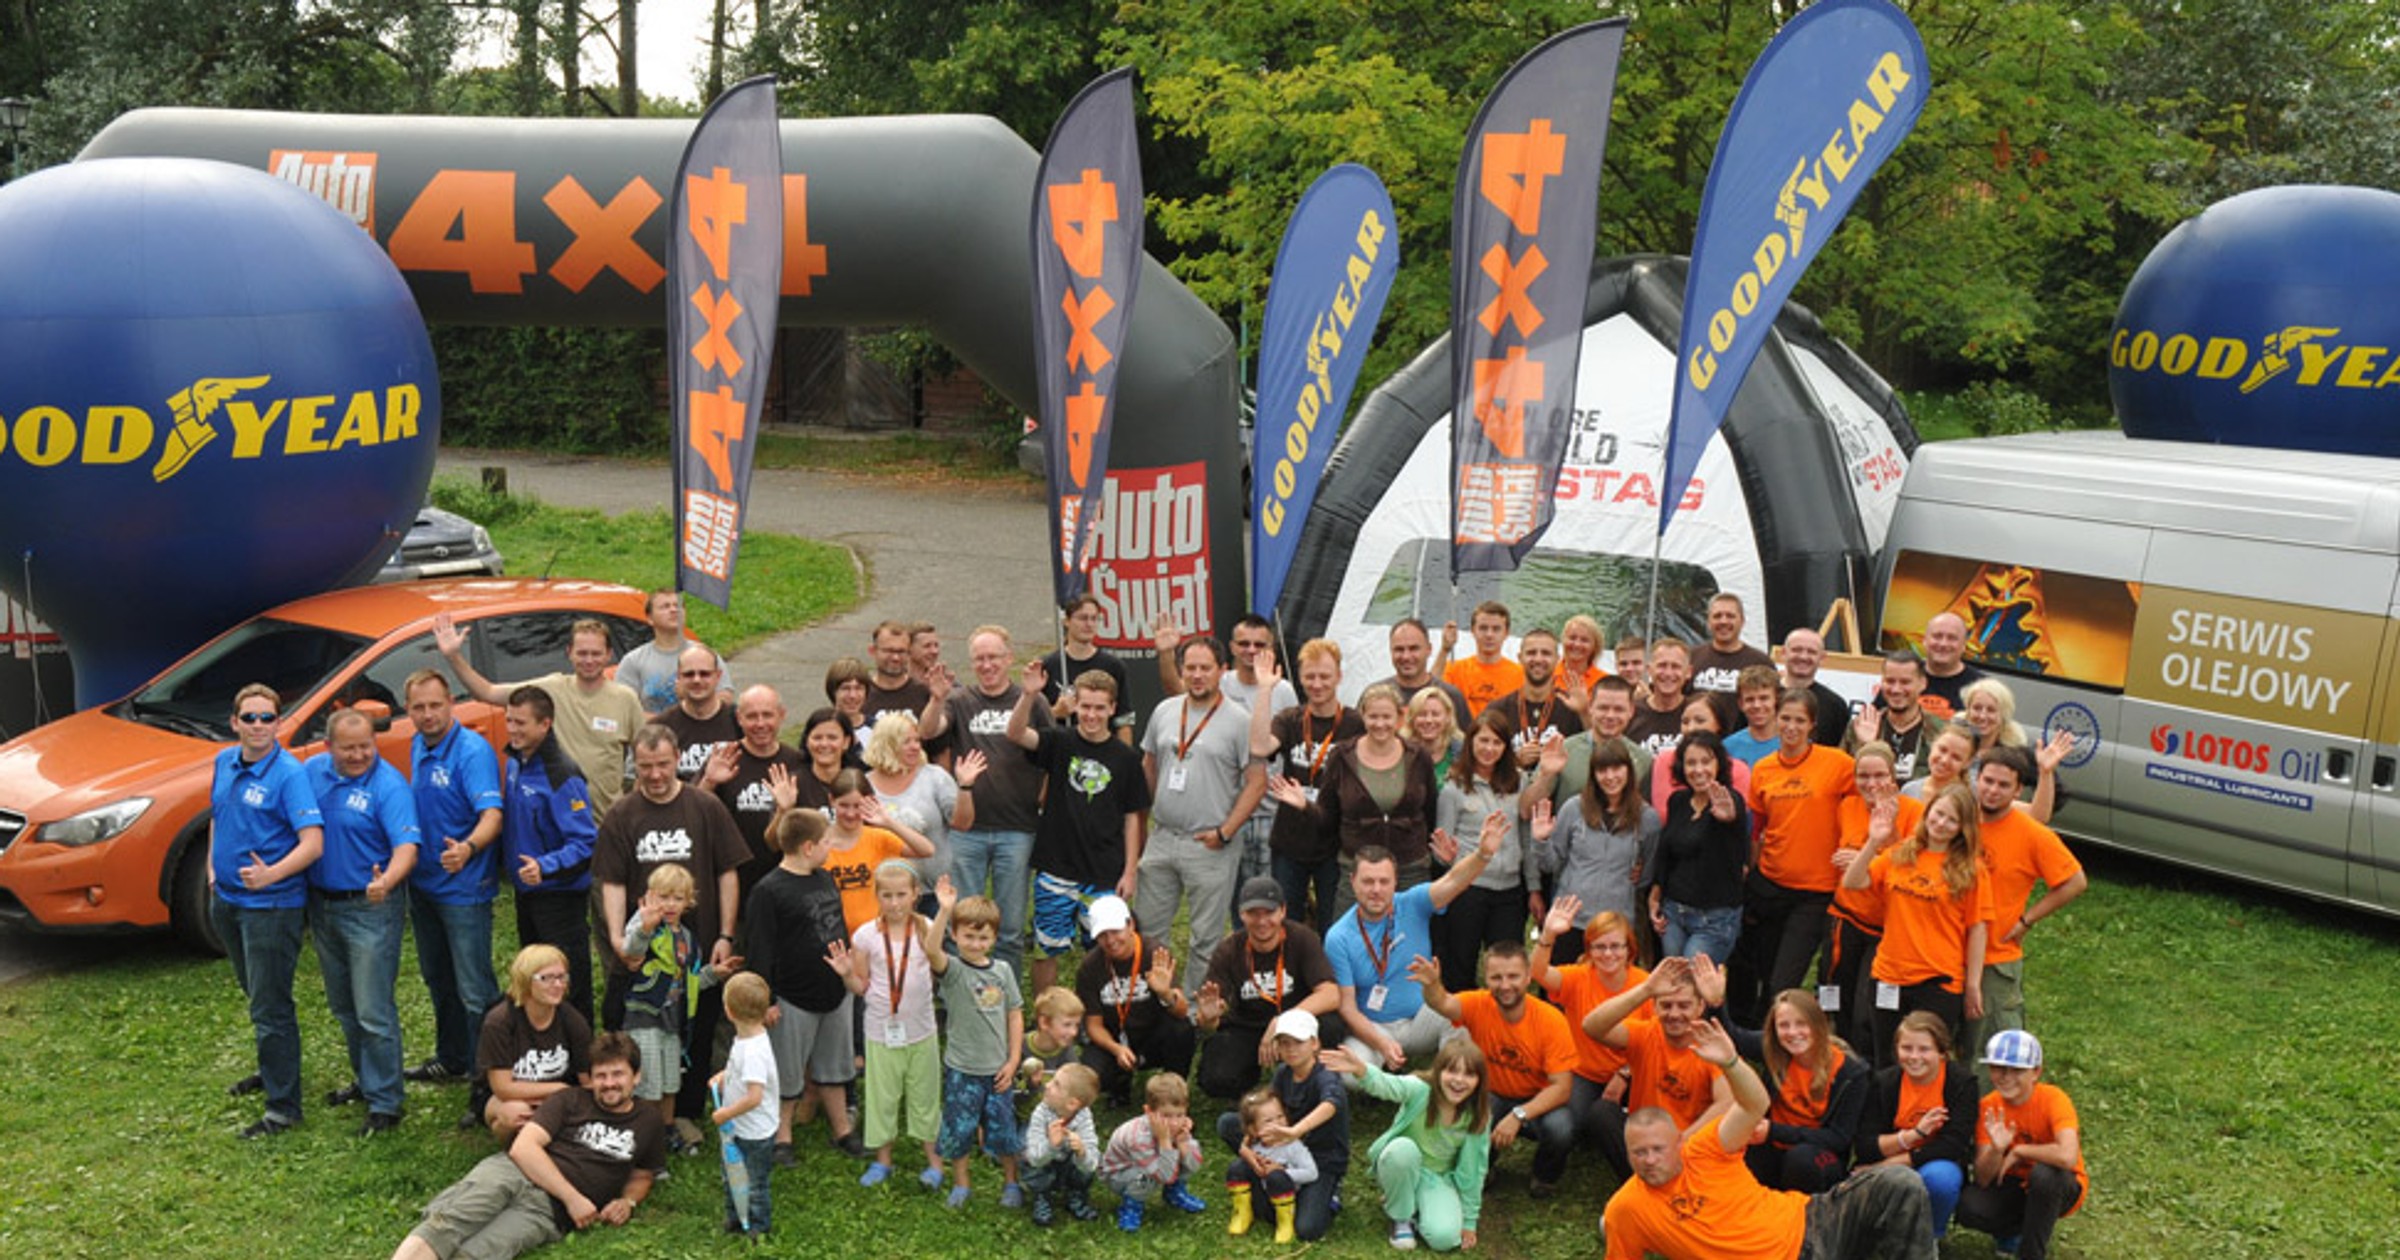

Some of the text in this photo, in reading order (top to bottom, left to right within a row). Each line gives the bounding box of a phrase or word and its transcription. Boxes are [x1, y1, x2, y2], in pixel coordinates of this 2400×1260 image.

[2296, 343, 2400, 388] YEA
[1088, 471, 1203, 560] Auto
[2168, 608, 2314, 662] SERWIS
[2161, 652, 2352, 714] OLEJOWY
[2183, 730, 2321, 784] LOTOS Oil
[2149, 767, 2308, 808] INDUSTRIAL LUBRICANTS
